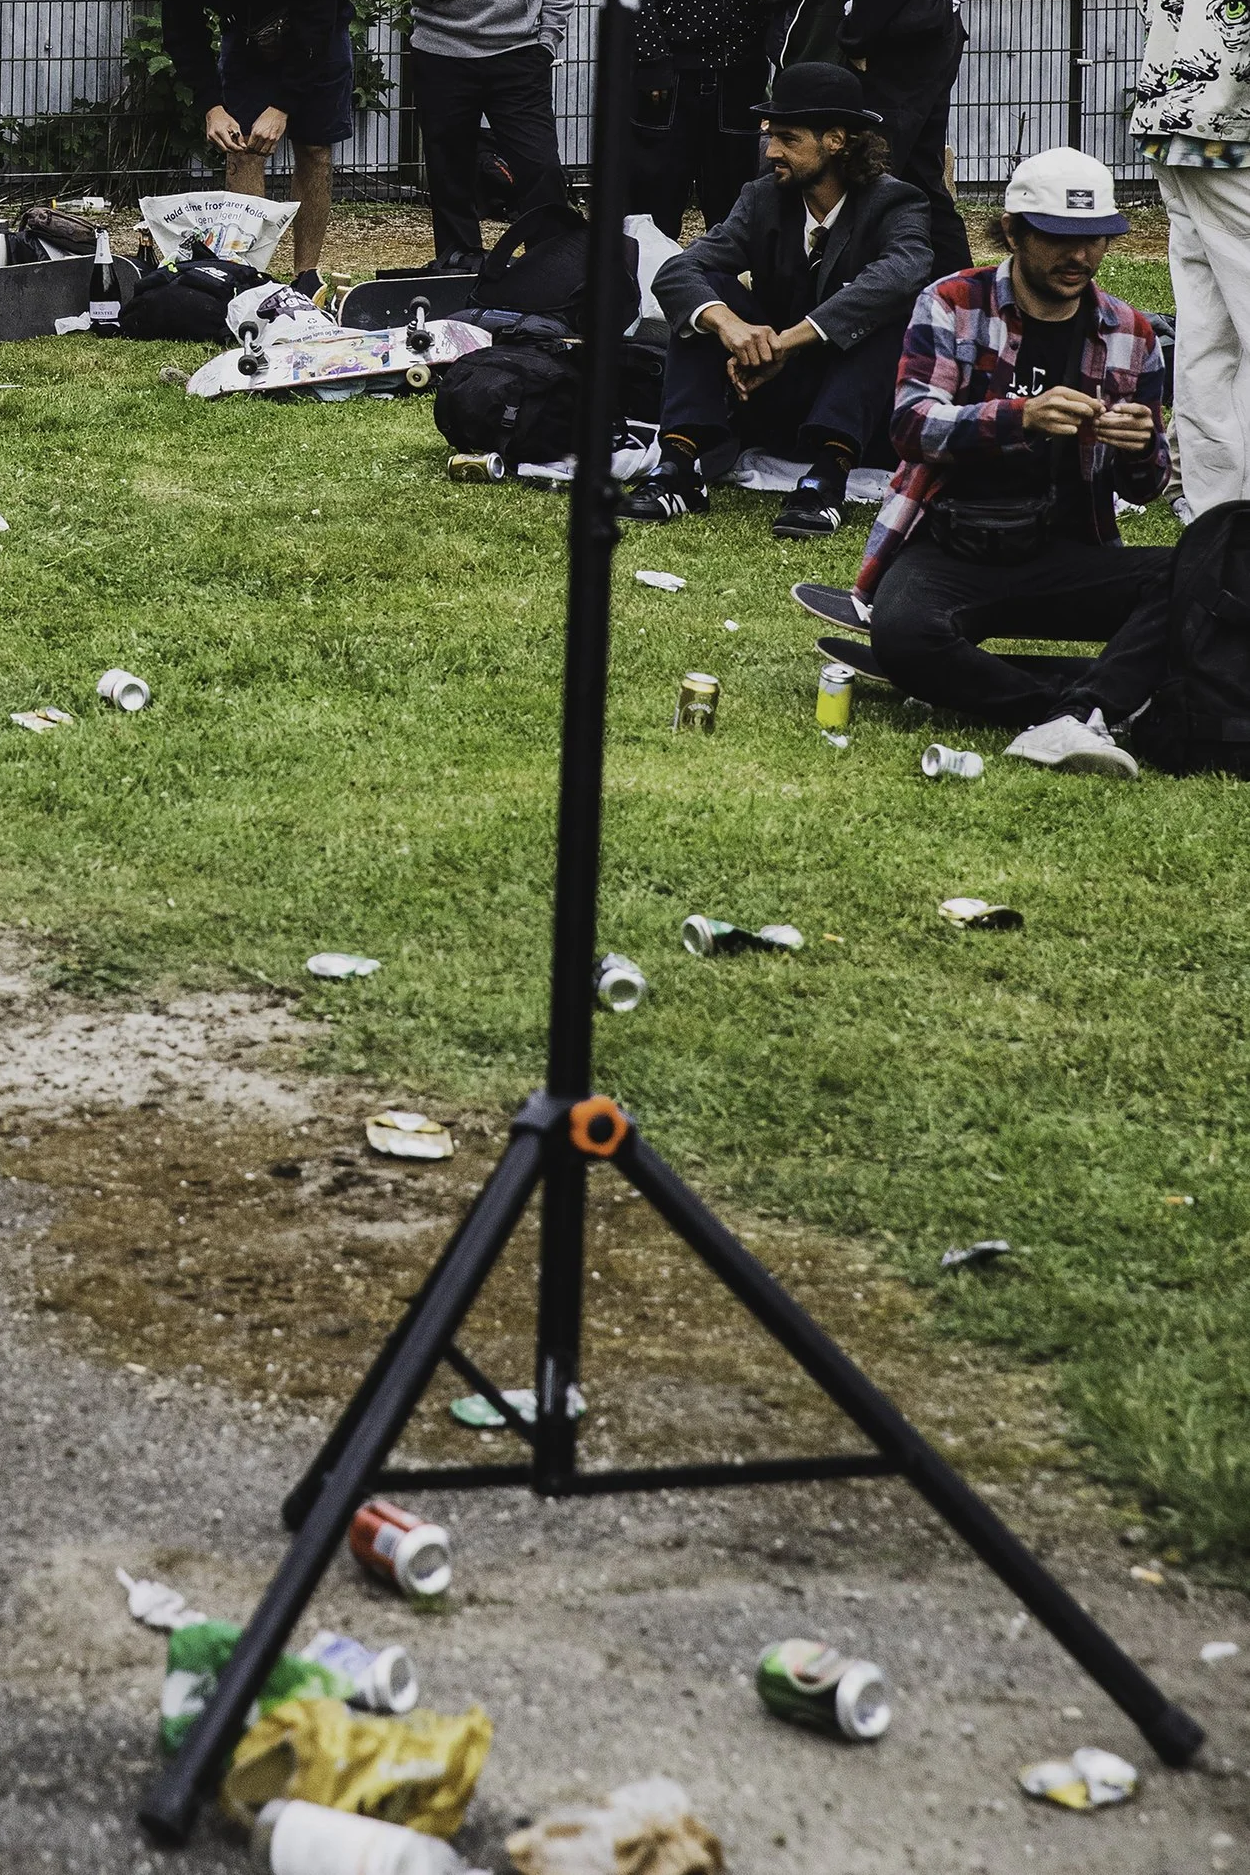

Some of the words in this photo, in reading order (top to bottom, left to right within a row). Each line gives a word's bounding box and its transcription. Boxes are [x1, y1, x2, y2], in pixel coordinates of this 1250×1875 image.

[163, 206, 184, 223] Hold
[184, 202, 203, 212] dine
[244, 204, 268, 220] kolde
